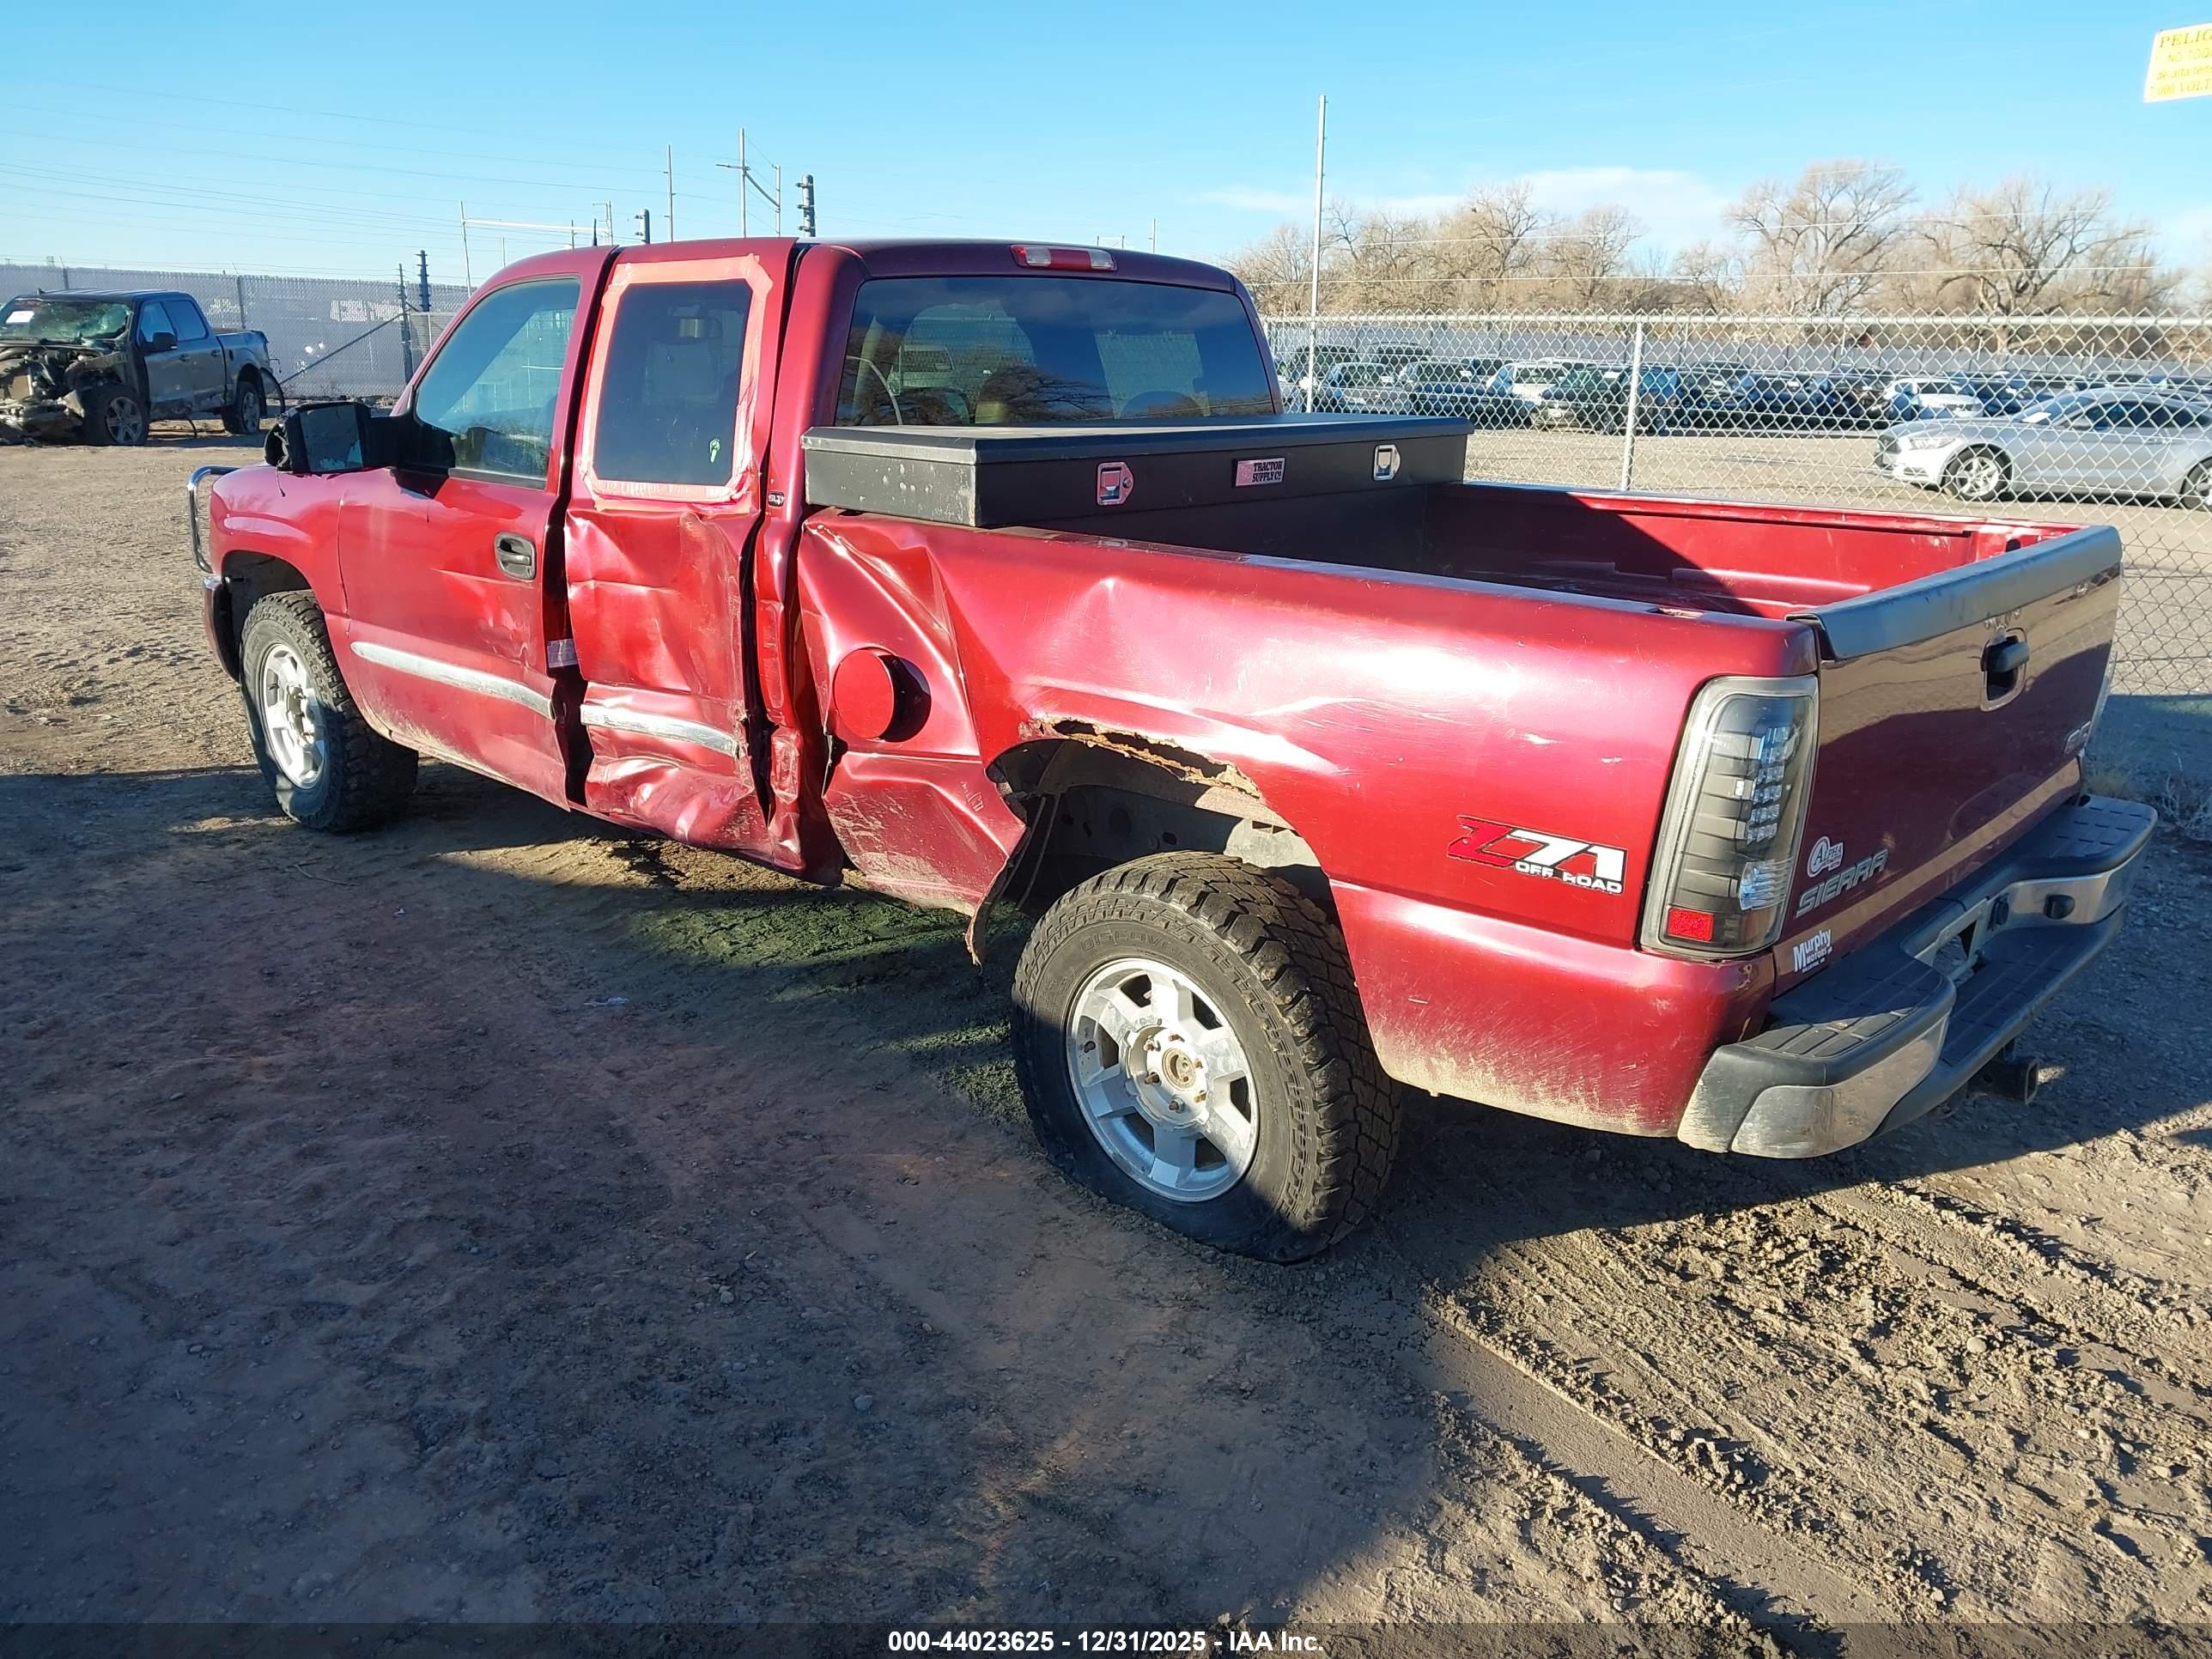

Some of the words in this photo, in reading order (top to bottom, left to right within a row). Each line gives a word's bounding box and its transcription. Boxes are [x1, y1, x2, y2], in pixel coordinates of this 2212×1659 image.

[1252, 471, 1276, 483] SUPPLY
[1253, 460, 1283, 472] TRACTOR
[1447, 815, 1627, 881] Z71
[1515, 860, 1554, 878] OFF
[1562, 871, 1623, 894] ROAD
[1795, 848, 1889, 919] SIERRA
[1793, 928, 1832, 973] Murphy
